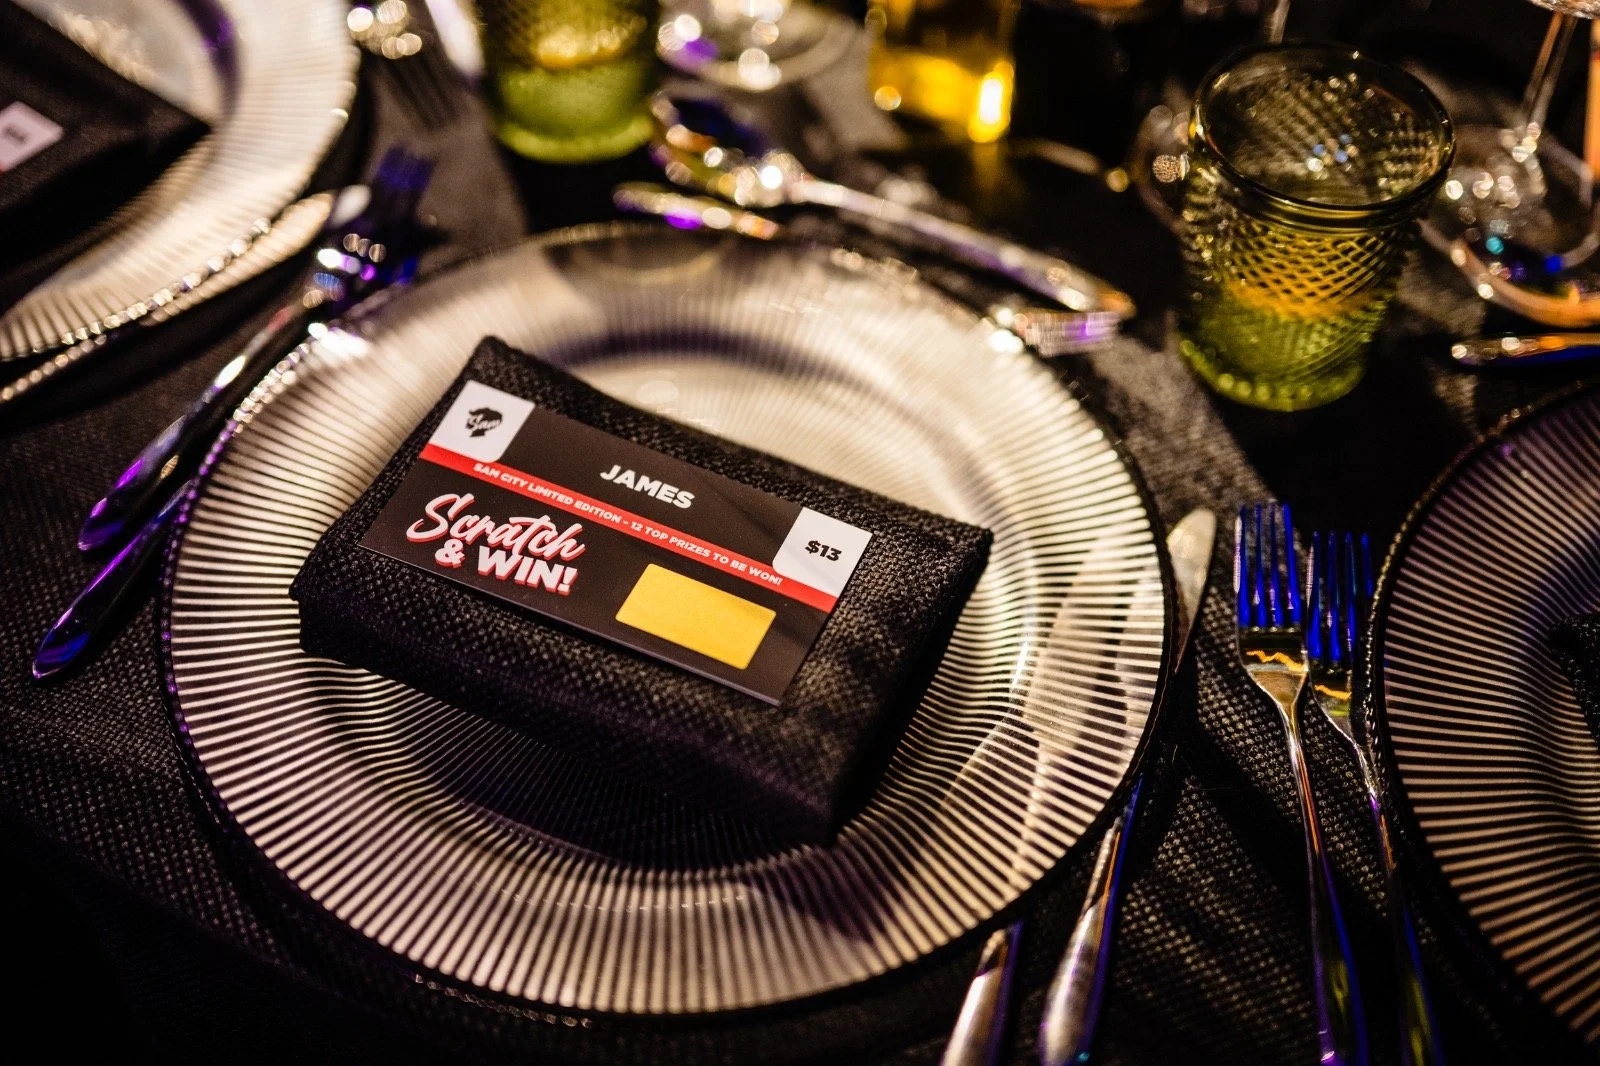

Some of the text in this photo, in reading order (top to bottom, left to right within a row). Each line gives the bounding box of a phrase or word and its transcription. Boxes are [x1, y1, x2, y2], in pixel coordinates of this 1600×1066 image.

[600, 465, 695, 509] JAMES
[406, 493, 586, 561] Scratch
[473, 463, 500, 479] SAM
[500, 472, 528, 489] CITY
[528, 481, 574, 505] LIMITED
[574, 495, 622, 524] EDITION
[630, 521, 644, 532] 12
[645, 526, 669, 541] TOP
[669, 536, 711, 558] PRIZES
[713, 553, 729, 565] TO
[730, 559, 748, 573] BE
[749, 566, 783, 587] WON!
[805, 540, 842, 562] $13
[435, 538, 579, 596] & WIN!
